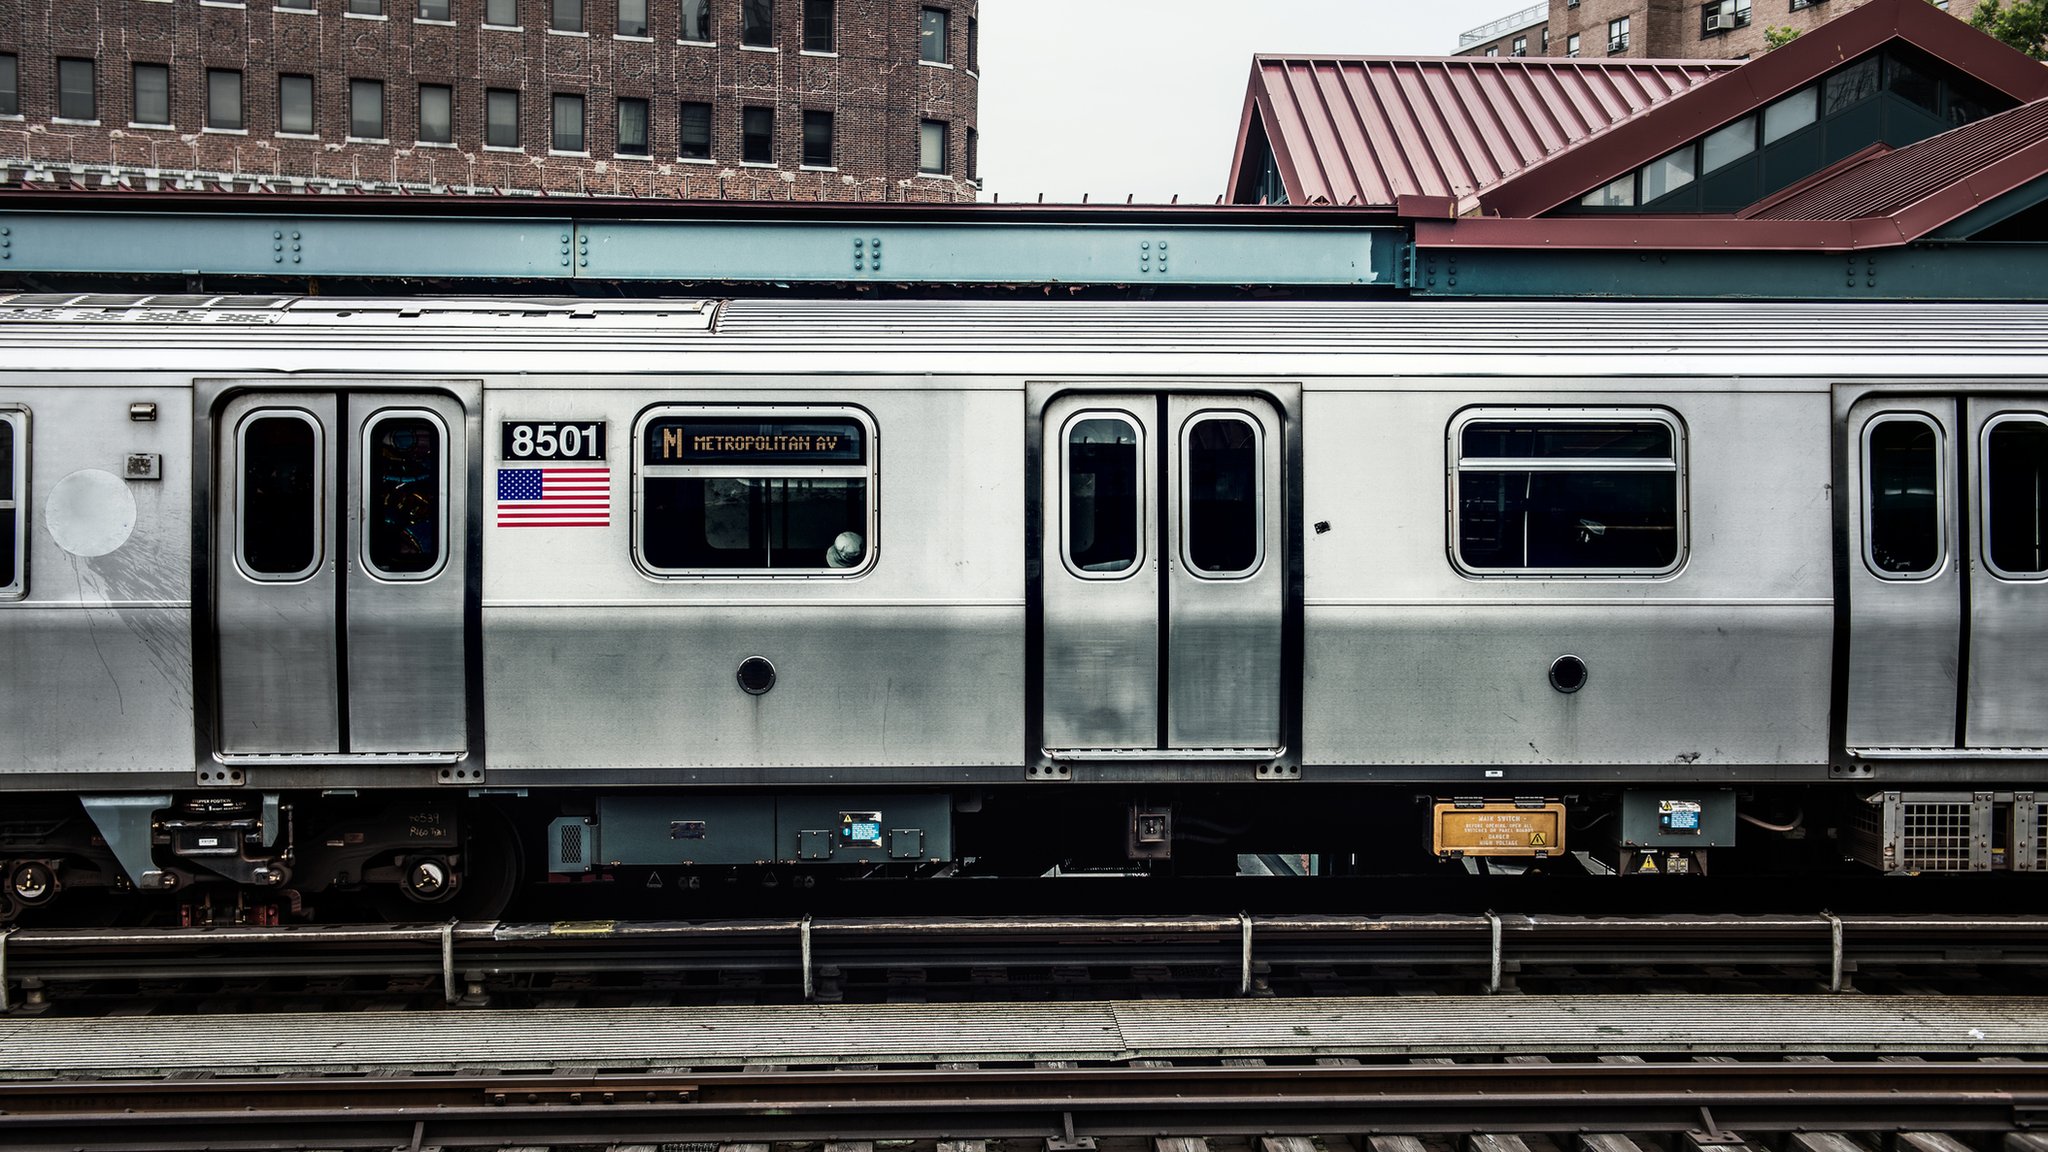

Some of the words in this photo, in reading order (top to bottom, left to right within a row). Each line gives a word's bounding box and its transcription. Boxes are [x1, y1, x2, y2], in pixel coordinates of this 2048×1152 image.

[512, 425, 597, 457] 8501
[663, 428, 683, 458] M
[694, 436, 810, 450] METROPOLITAN
[816, 436, 838, 450] AV
